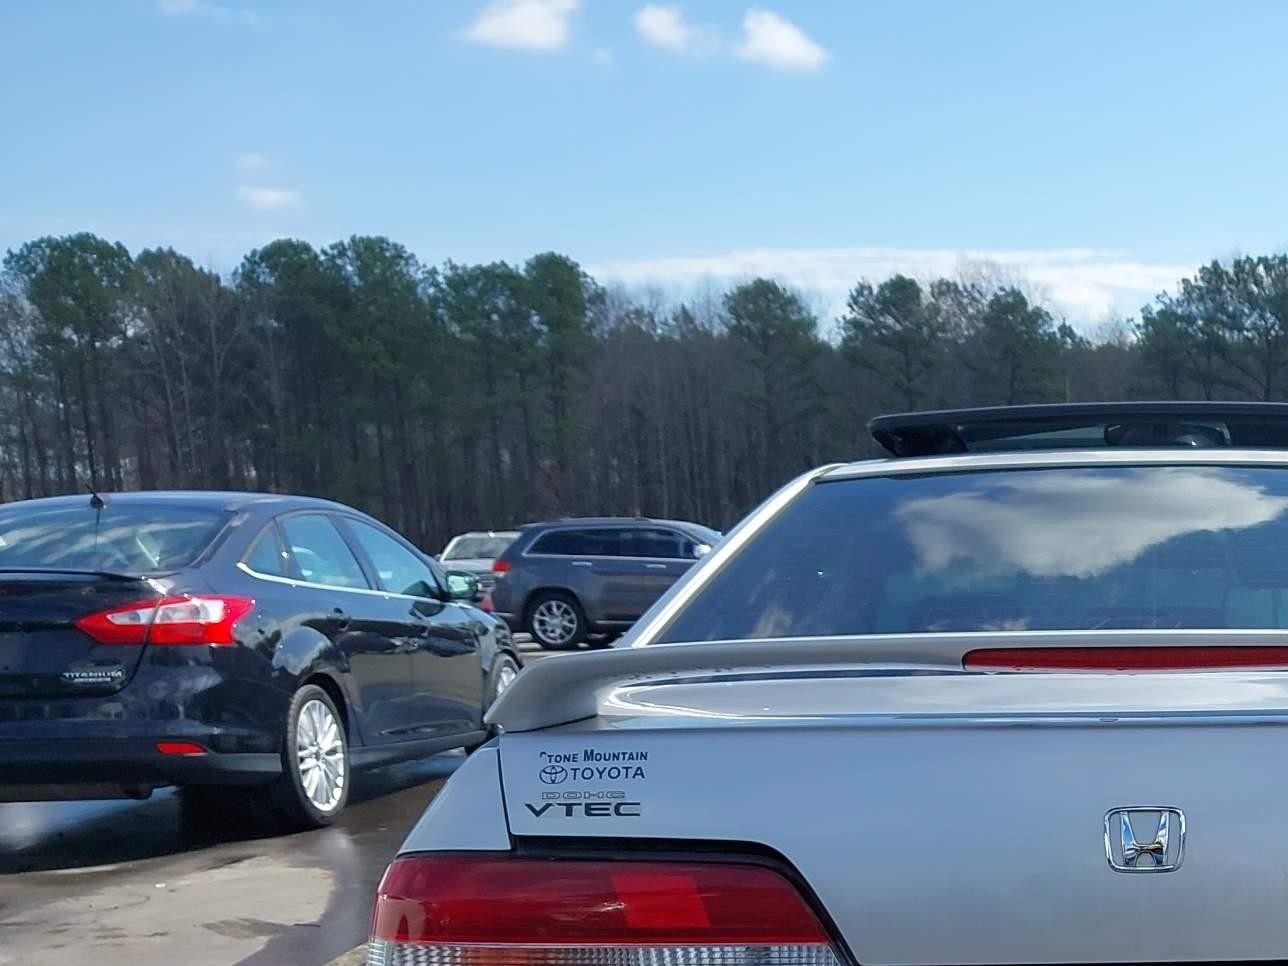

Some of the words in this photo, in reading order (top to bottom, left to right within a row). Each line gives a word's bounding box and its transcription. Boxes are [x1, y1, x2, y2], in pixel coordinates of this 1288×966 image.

[583, 749, 648, 762] MOUNTAIN
[570, 766, 646, 781] TOYOTA
[541, 790, 626, 800] DOHC
[525, 802, 641, 818] VTEC
